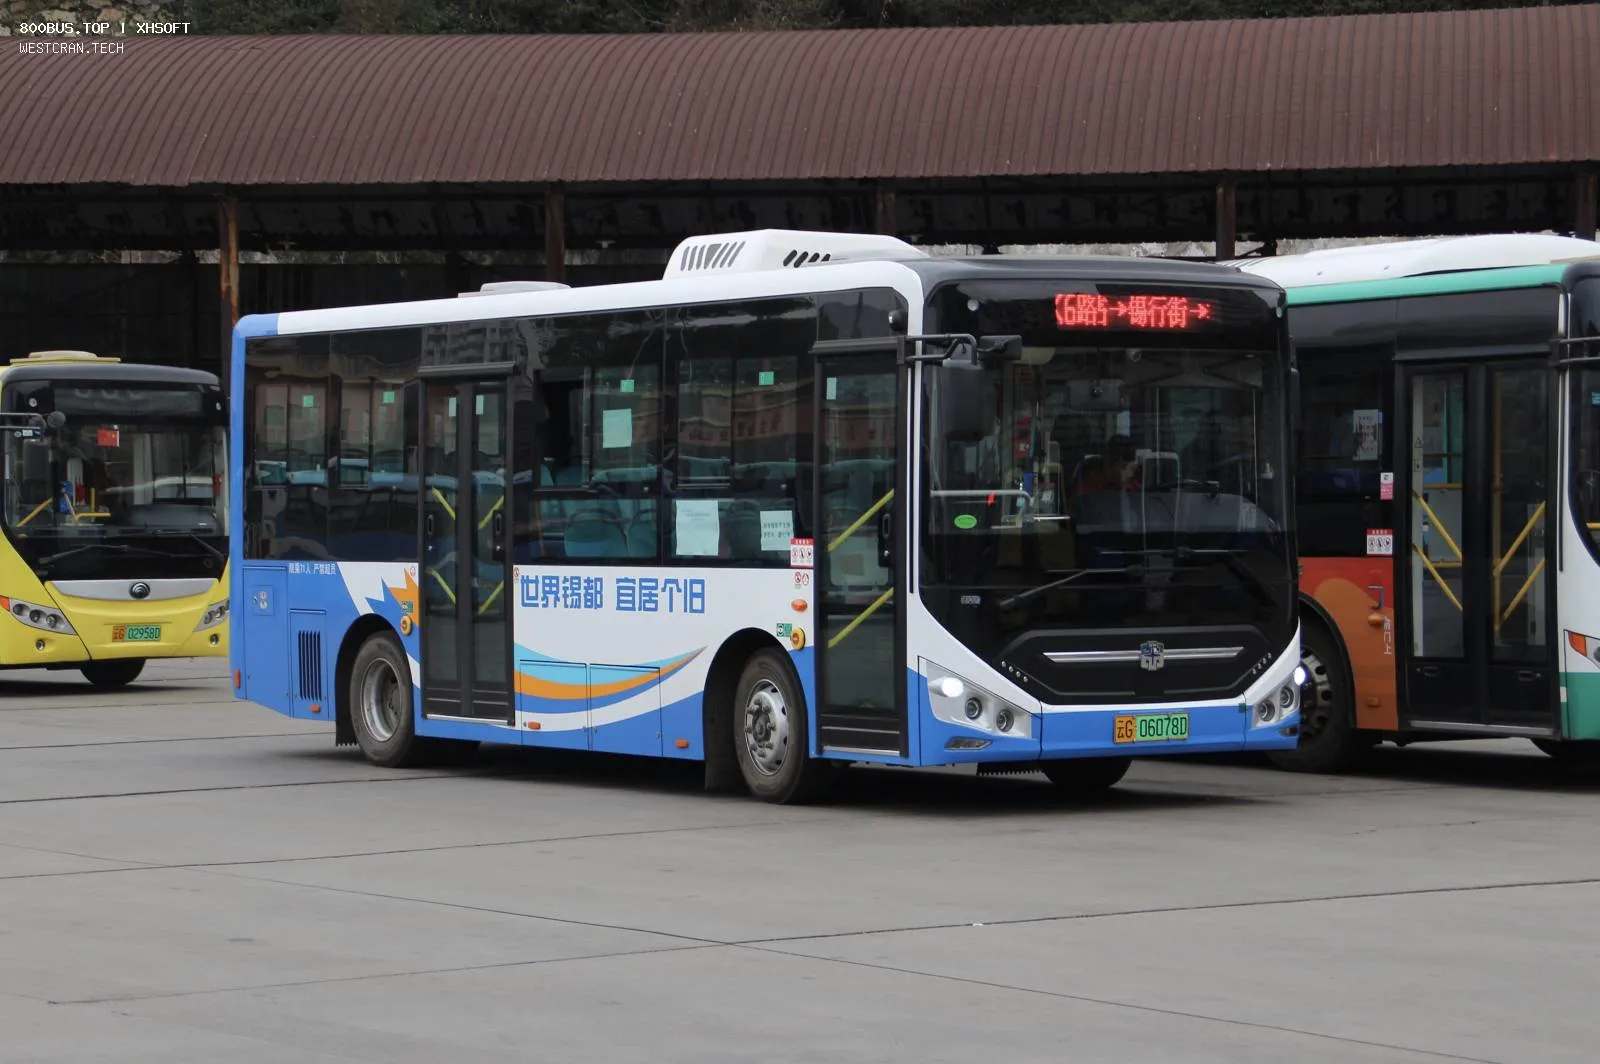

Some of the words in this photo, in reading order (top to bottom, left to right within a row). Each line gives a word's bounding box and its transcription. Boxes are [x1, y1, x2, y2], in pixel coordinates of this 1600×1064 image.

[520, 575, 603, 609] 世界锡都
[615, 577, 705, 614] 宜居个旧
